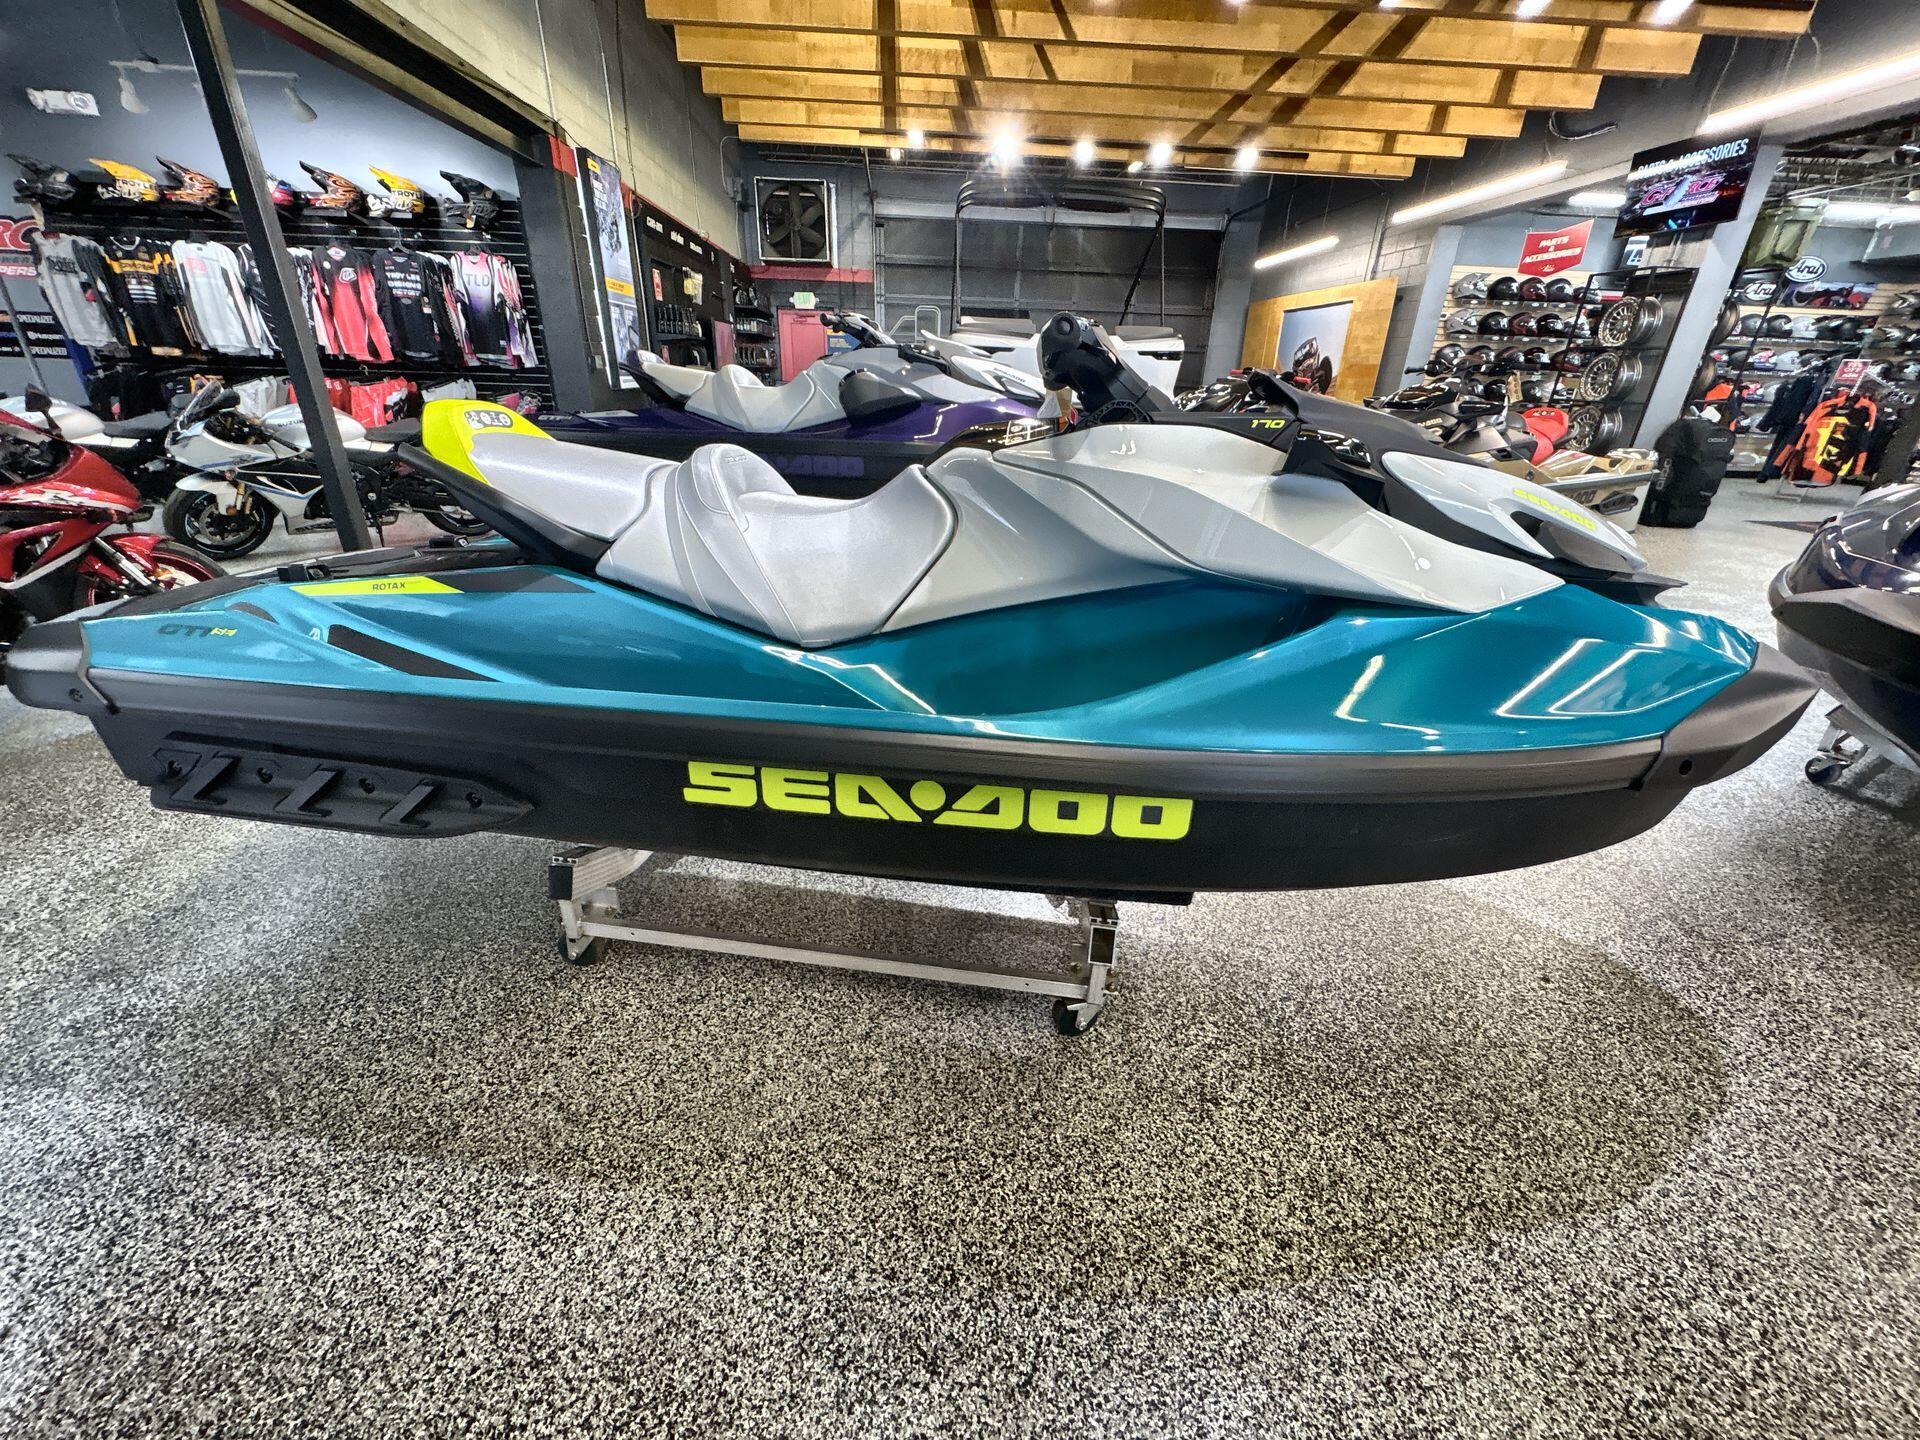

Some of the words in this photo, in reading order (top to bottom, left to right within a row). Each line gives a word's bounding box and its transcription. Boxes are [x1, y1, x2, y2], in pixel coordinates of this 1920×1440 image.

[1678, 138, 1749, 169] ACCESSORIES
[1539, 235, 1570, 248] PARTS
[1522, 246, 1583, 264] ACCESSORIES
[465, 273, 490, 287] TLD
[276, 419, 304, 428] SUZUK
[1251, 419, 1286, 429] 170
[372, 581, 406, 591] ROTAX
